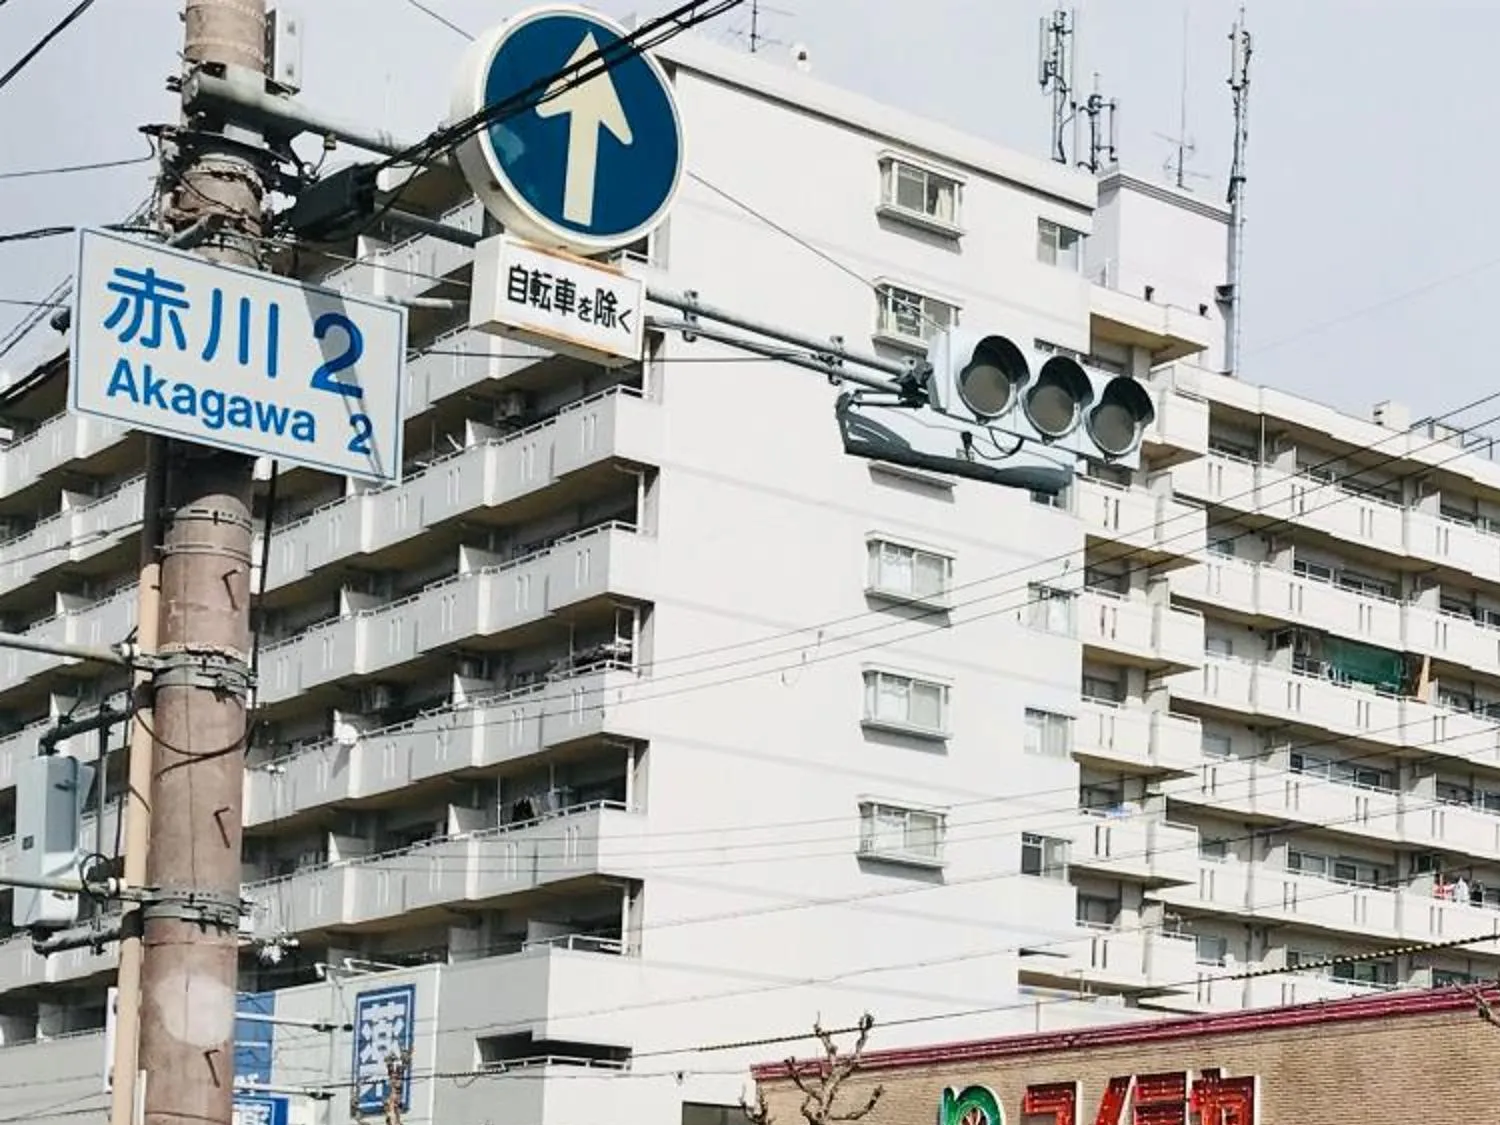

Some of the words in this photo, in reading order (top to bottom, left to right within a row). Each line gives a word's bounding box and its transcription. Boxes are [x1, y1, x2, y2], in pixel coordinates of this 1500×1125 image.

[507, 264, 632, 335] 自転車を除く
[106, 357, 315, 443] Akagawa
[347, 413, 373, 455] 2
